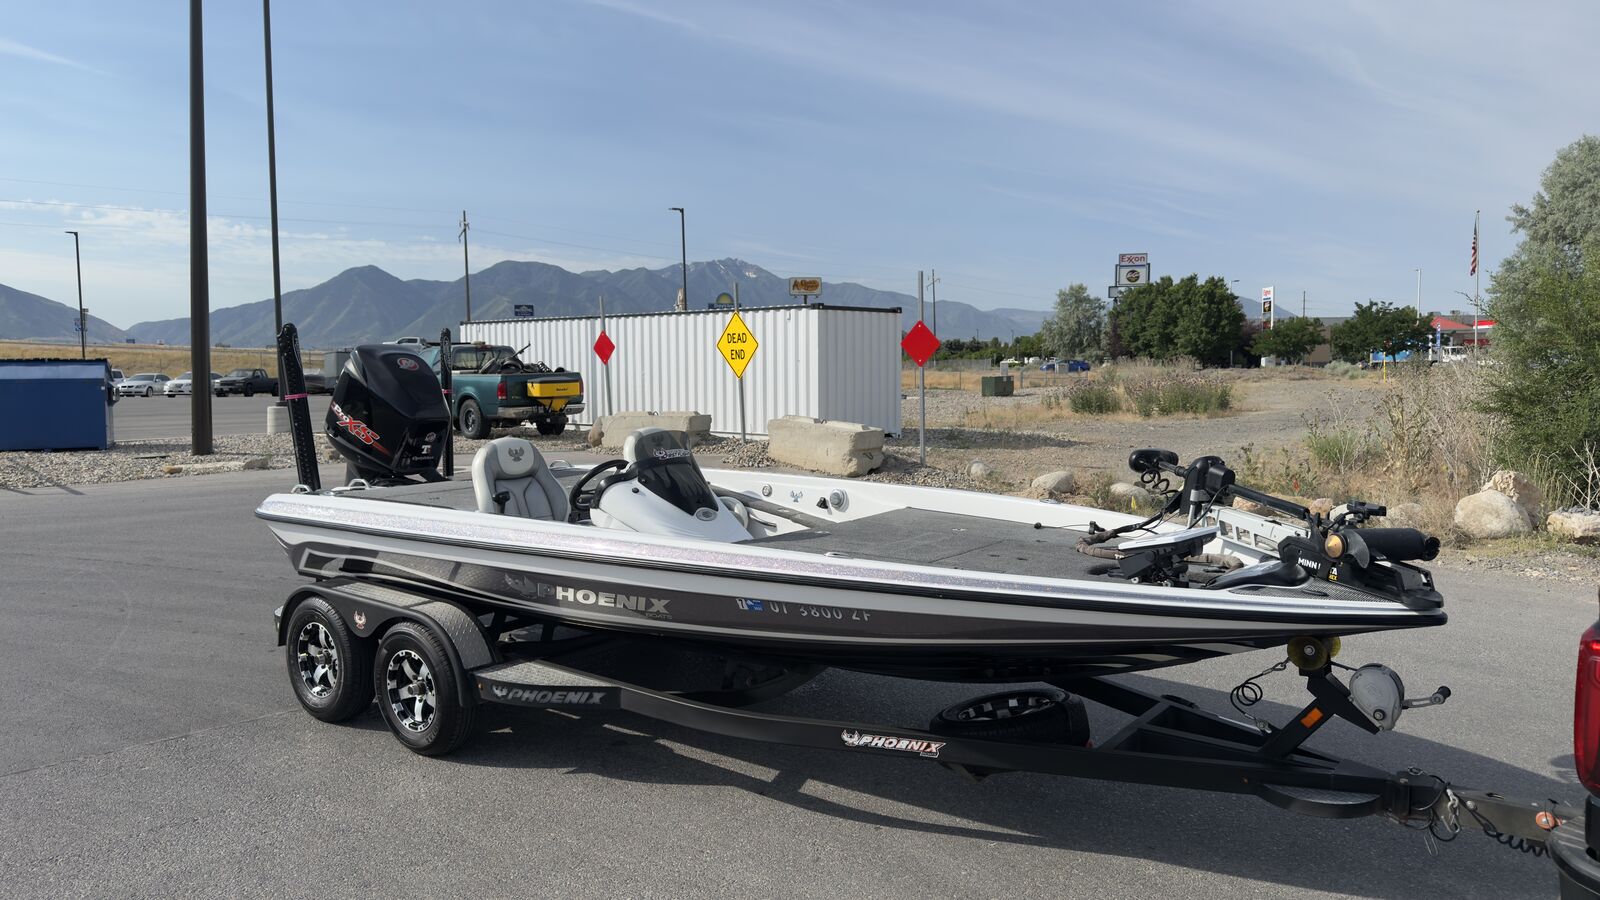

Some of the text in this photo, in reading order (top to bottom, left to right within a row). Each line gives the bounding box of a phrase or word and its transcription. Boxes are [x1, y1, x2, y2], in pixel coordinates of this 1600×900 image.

[1121, 255, 1146, 264] Exxon
[727, 333, 747, 344] DEAD
[730, 349, 745, 360] END
[1298, 557, 1317, 570] MINN
[537, 583, 671, 613] PHOENIX
[508, 688, 607, 705] PHOENIX
[859, 735, 942, 753] PHOENIX
